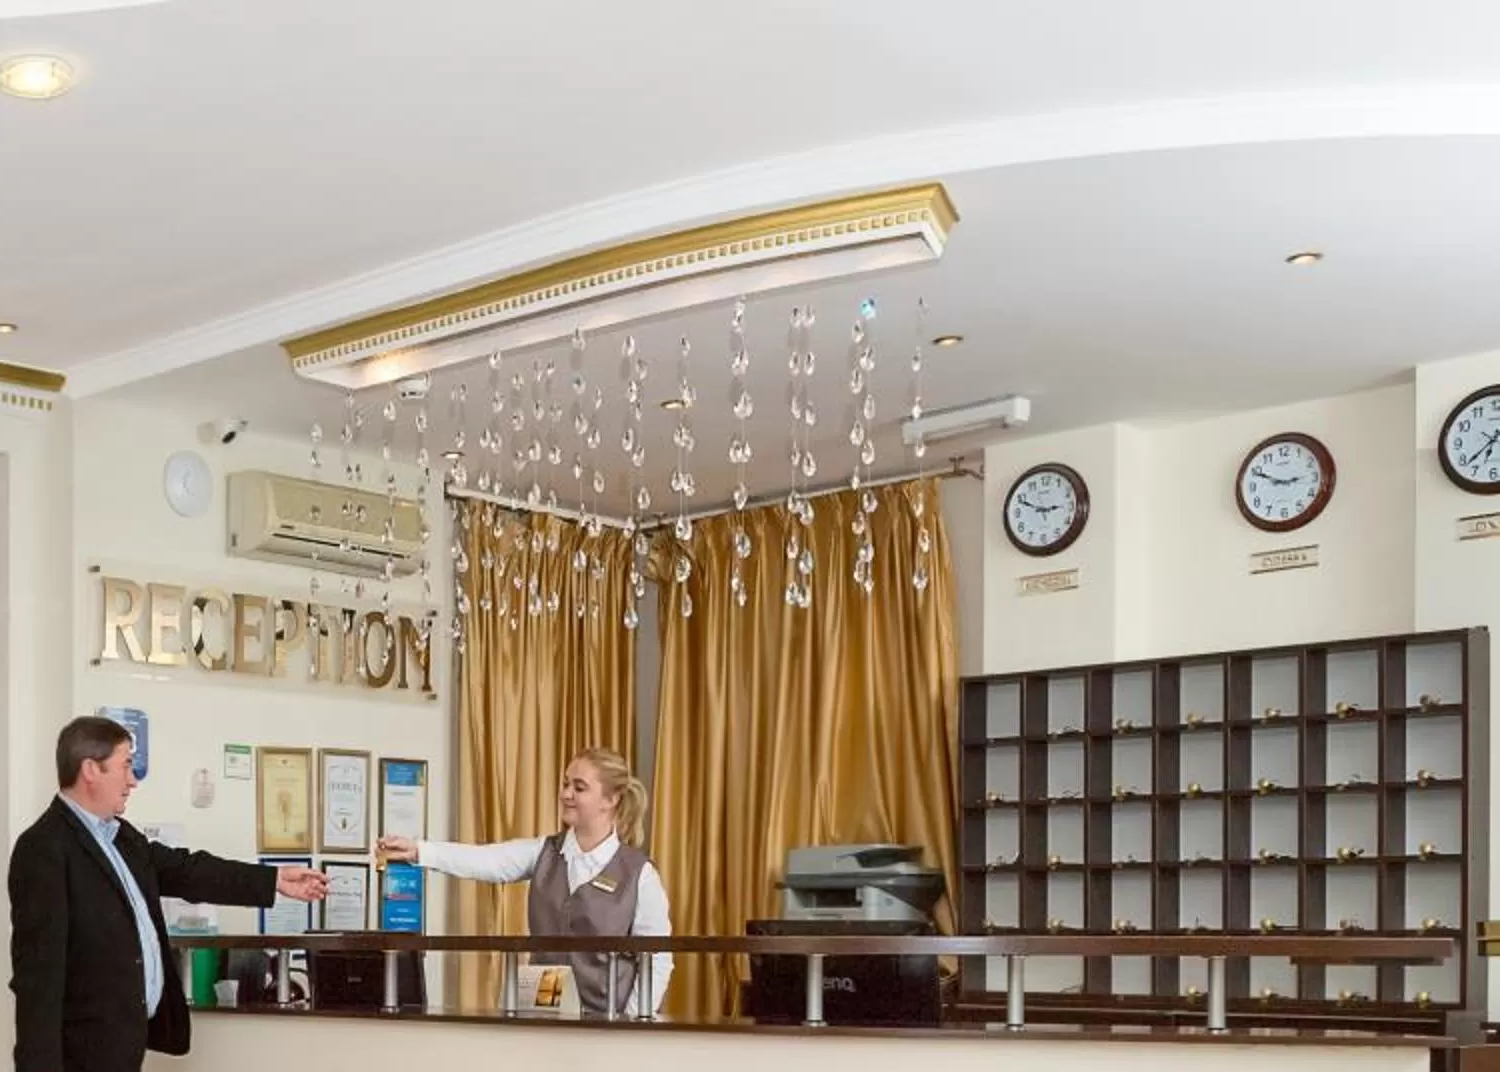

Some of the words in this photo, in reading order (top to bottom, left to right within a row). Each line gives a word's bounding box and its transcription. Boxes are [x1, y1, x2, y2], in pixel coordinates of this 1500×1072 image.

[1458, 419, 1471, 432] 10
[1454, 437, 1463, 449] 9
[101, 575, 434, 692] RECEPTION
